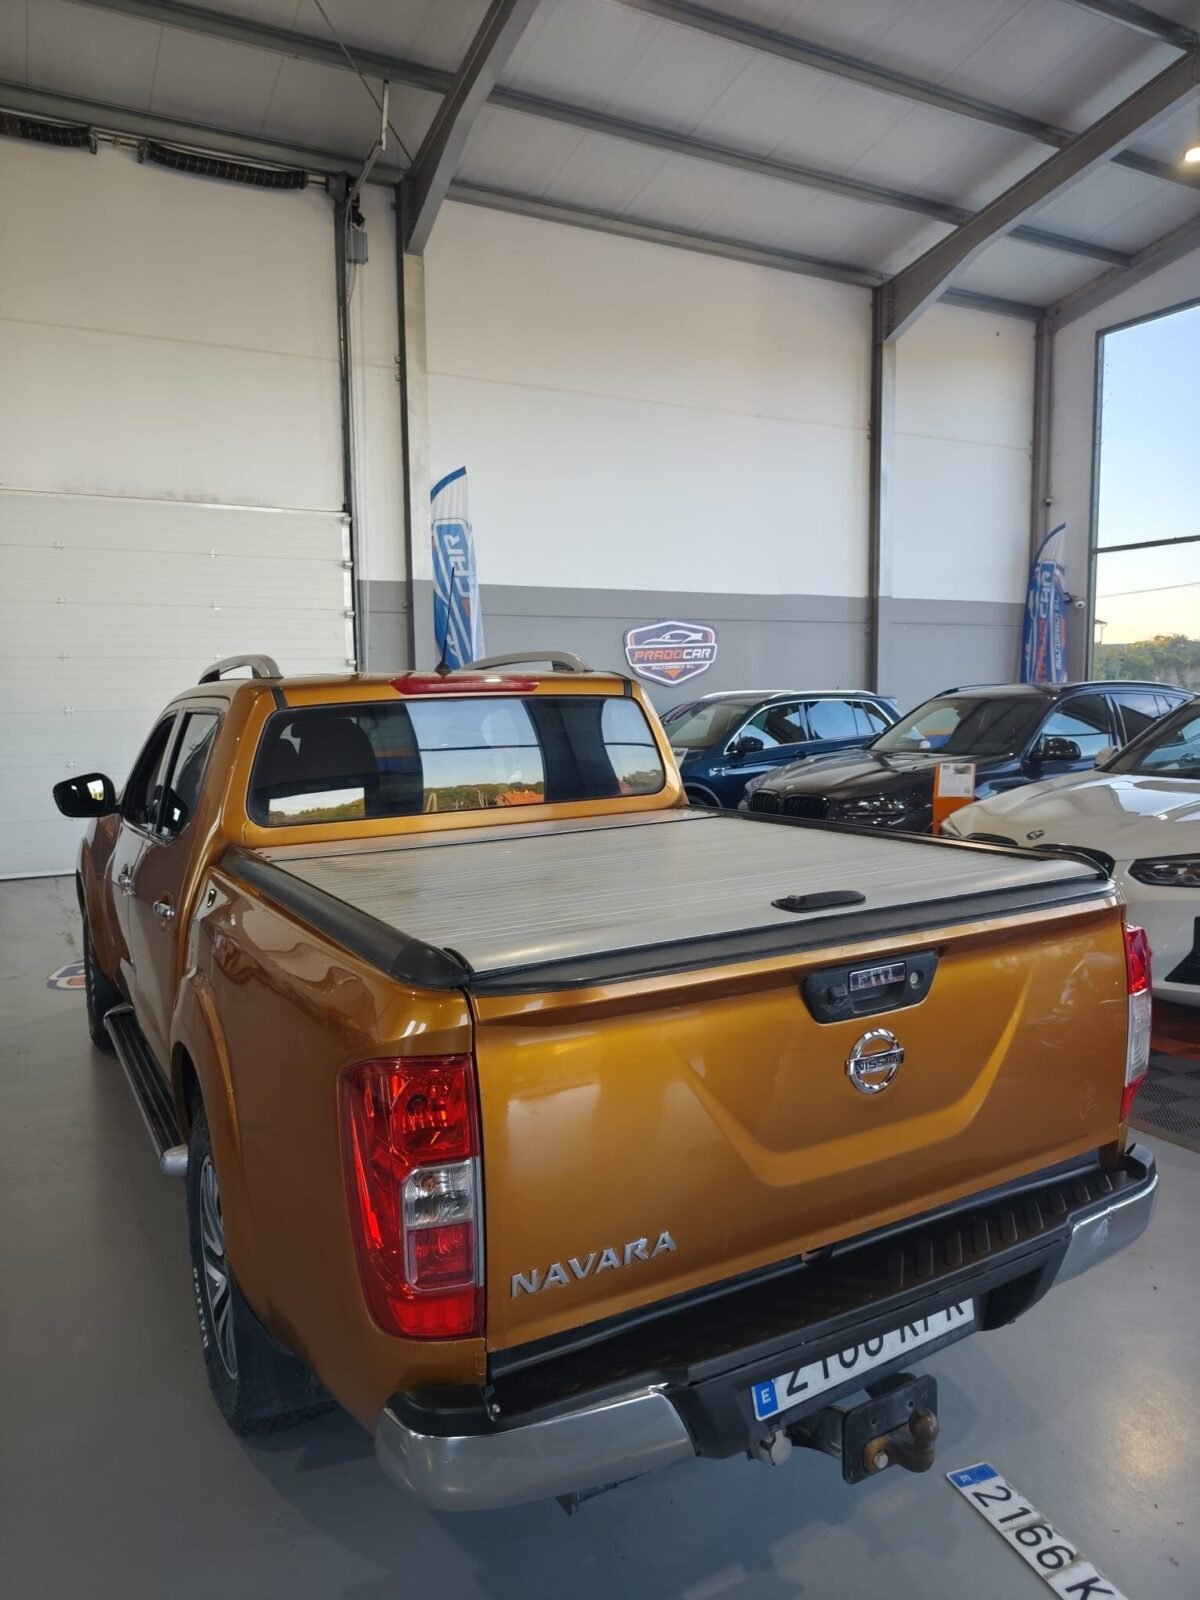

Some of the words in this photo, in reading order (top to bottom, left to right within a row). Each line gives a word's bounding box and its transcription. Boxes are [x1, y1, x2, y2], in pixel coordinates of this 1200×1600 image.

[633, 647, 711, 661] PRADOCAR
[855, 1053, 901, 1072] NISSAN
[510, 1230, 678, 1300] NAVARA
[760, 1388, 771, 1404] E
[971, 1485, 1075, 1570] 2166
